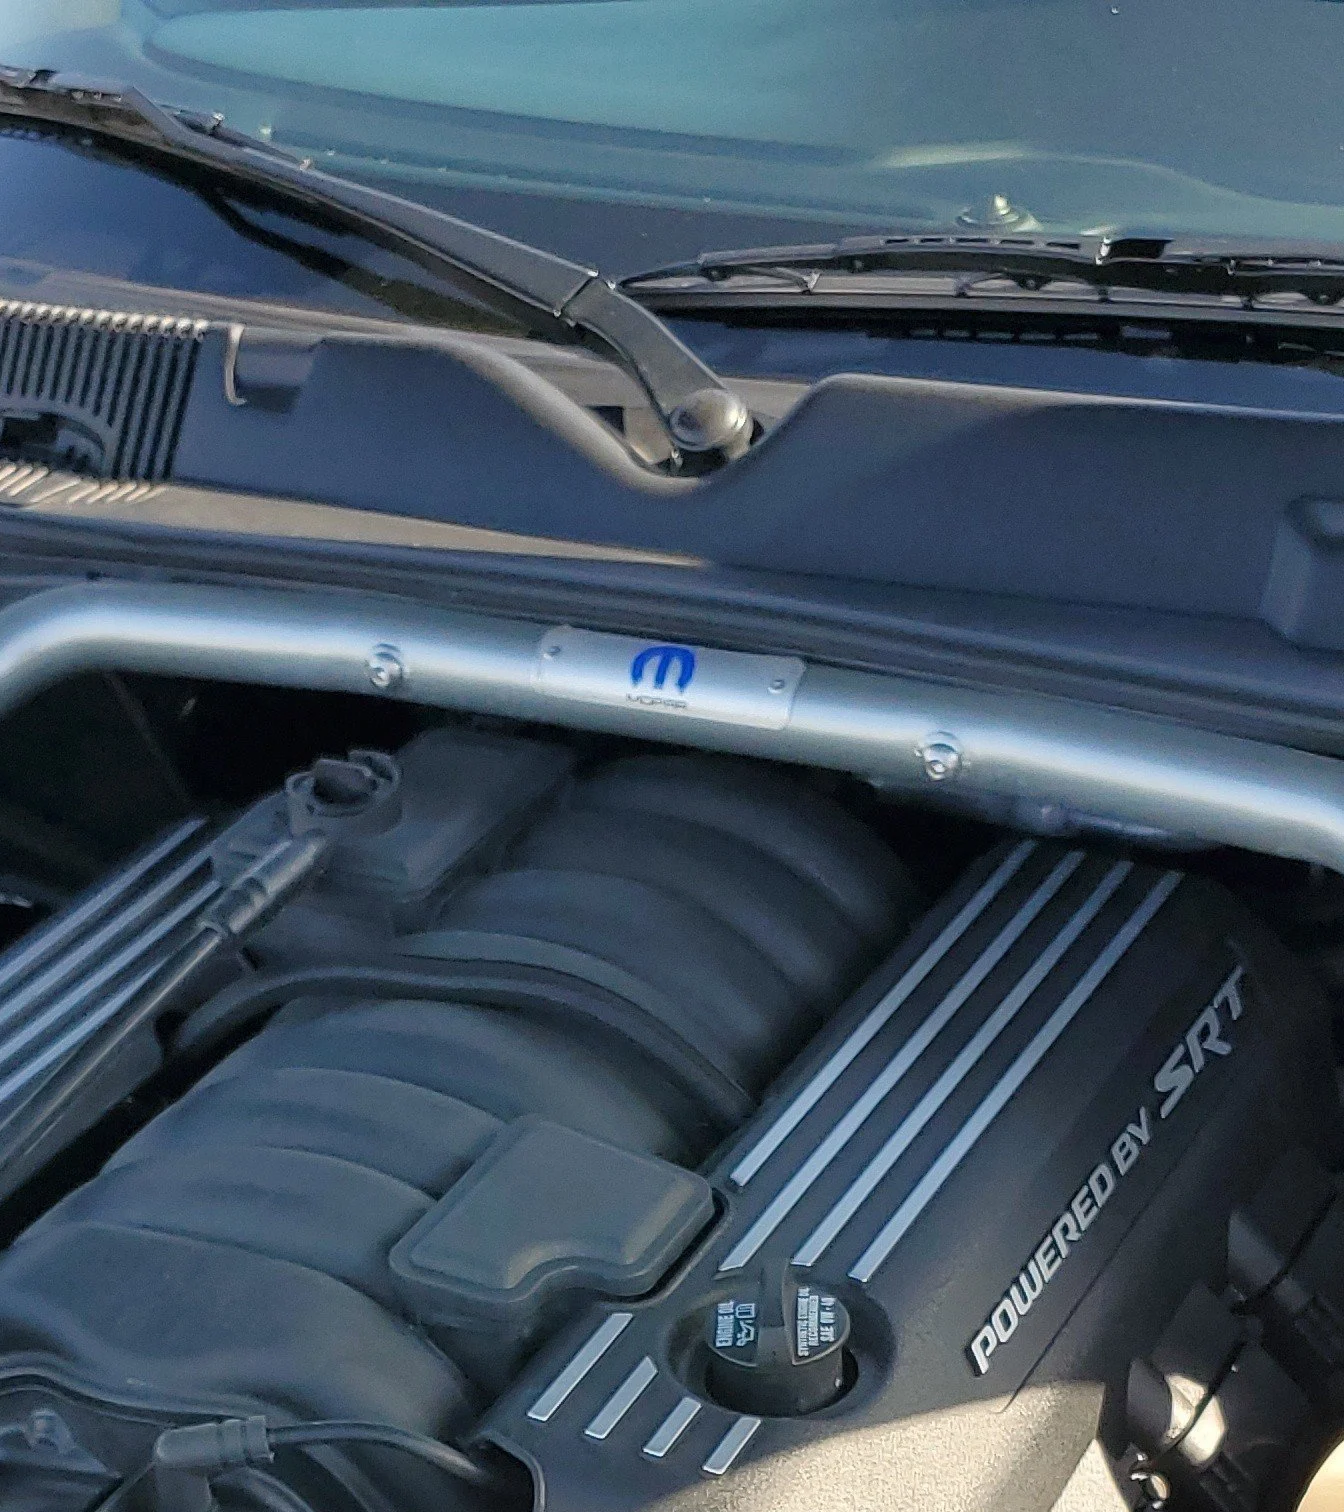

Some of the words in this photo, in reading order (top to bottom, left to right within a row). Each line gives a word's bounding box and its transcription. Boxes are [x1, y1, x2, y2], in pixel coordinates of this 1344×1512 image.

[968, 1163, 1117, 1375] POWERED
[1114, 1106, 1153, 1176] BY
[1153, 964, 1247, 1119] SRT
[717, 1301, 734, 1314] OIL
[716, 1315, 734, 1347] ENGINE
